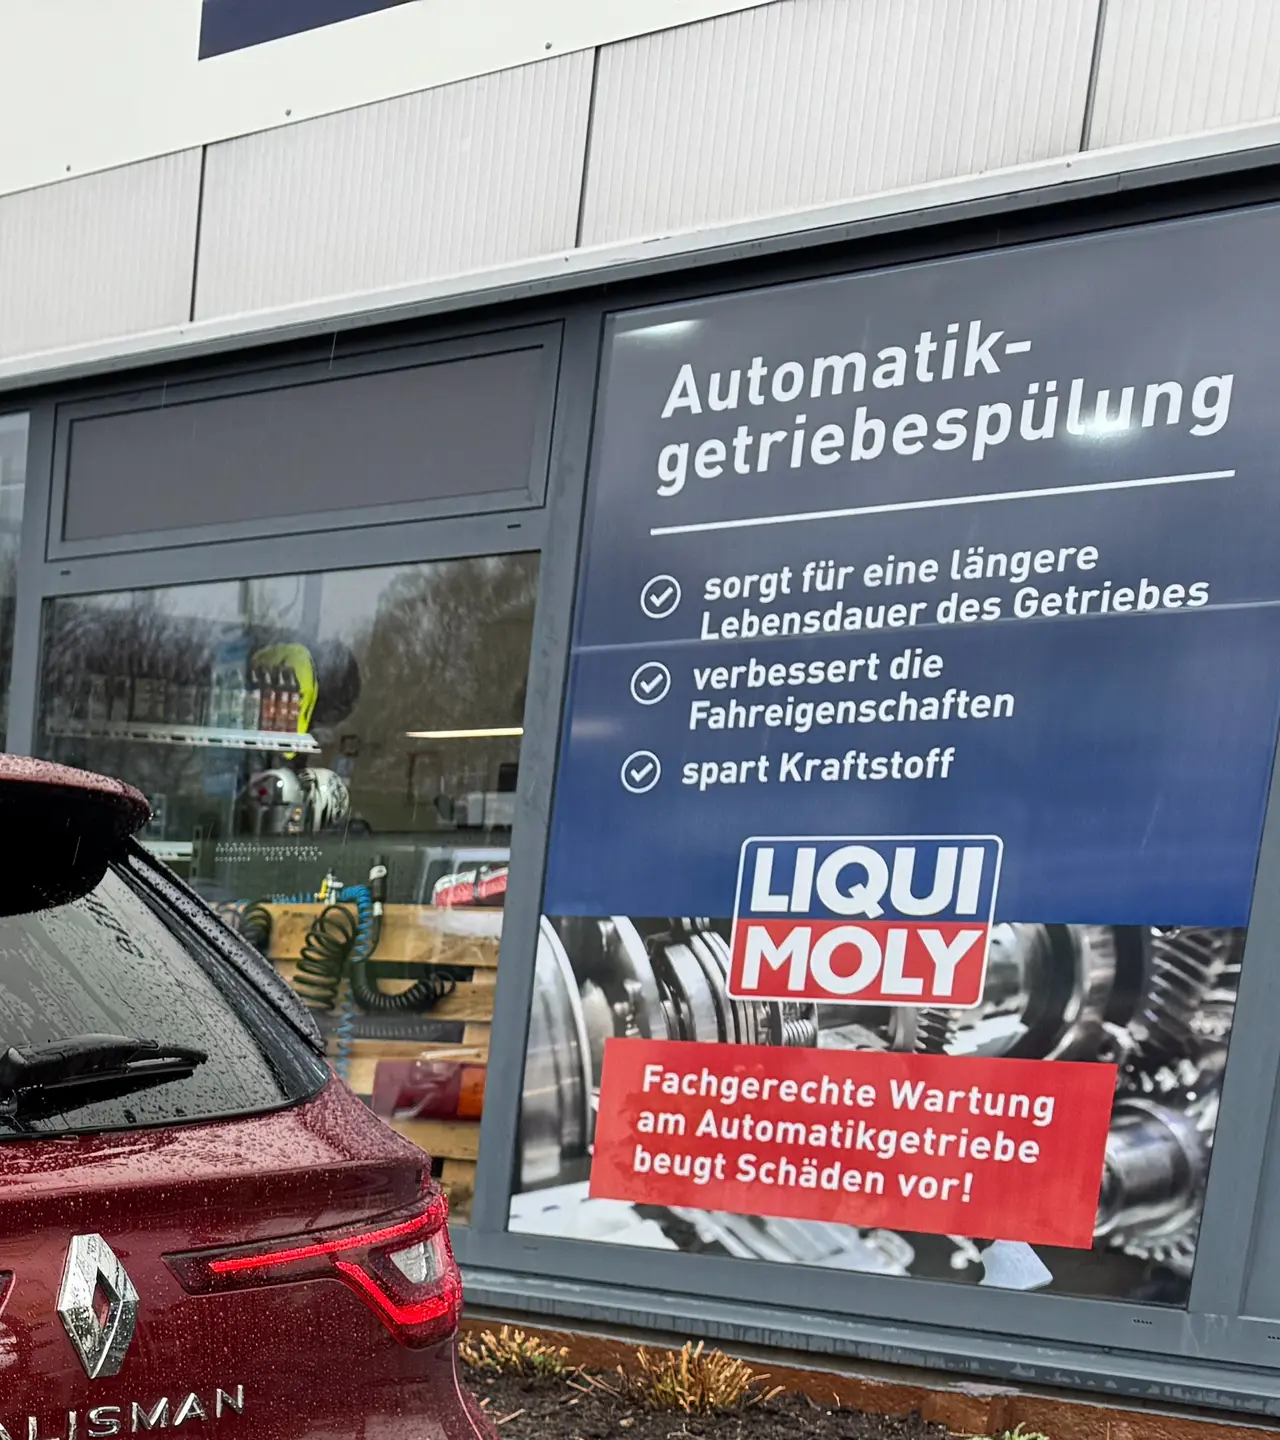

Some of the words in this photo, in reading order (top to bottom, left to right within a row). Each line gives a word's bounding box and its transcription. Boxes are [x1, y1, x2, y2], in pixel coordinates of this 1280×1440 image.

[661, 319, 1032, 418] Automatik-
[656, 374, 1234, 496] getriebespülung
[704, 566, 792, 604] sorgt
[802, 561, 853, 592] für
[863, 553, 939, 588] eine
[950, 545, 1099, 587] längere
[700, 600, 927, 641] Lebensdauer
[937, 592, 1002, 625] des
[1013, 577, 1210, 620] Getriebes
[693, 652, 881, 691] verbessert
[889, 647, 945, 681] die
[689, 688, 1016, 733] Fahreigenschaften
[681, 754, 770, 792] spart
[778, 746, 956, 783] Kraftstoff
[750, 845, 985, 919] LIQUI
[741, 925, 985, 997] MOLY
[642, 1064, 877, 1108] Fachgerechte
[890, 1079, 1056, 1127] Wartung
[637, 1110, 686, 1136] am
[695, 1109, 1041, 1165] Automatikgetriebe
[633, 1144, 726, 1185] beugt
[736, 1153, 885, 1195] Schäden
[897, 1172, 975, 1203] vor!
